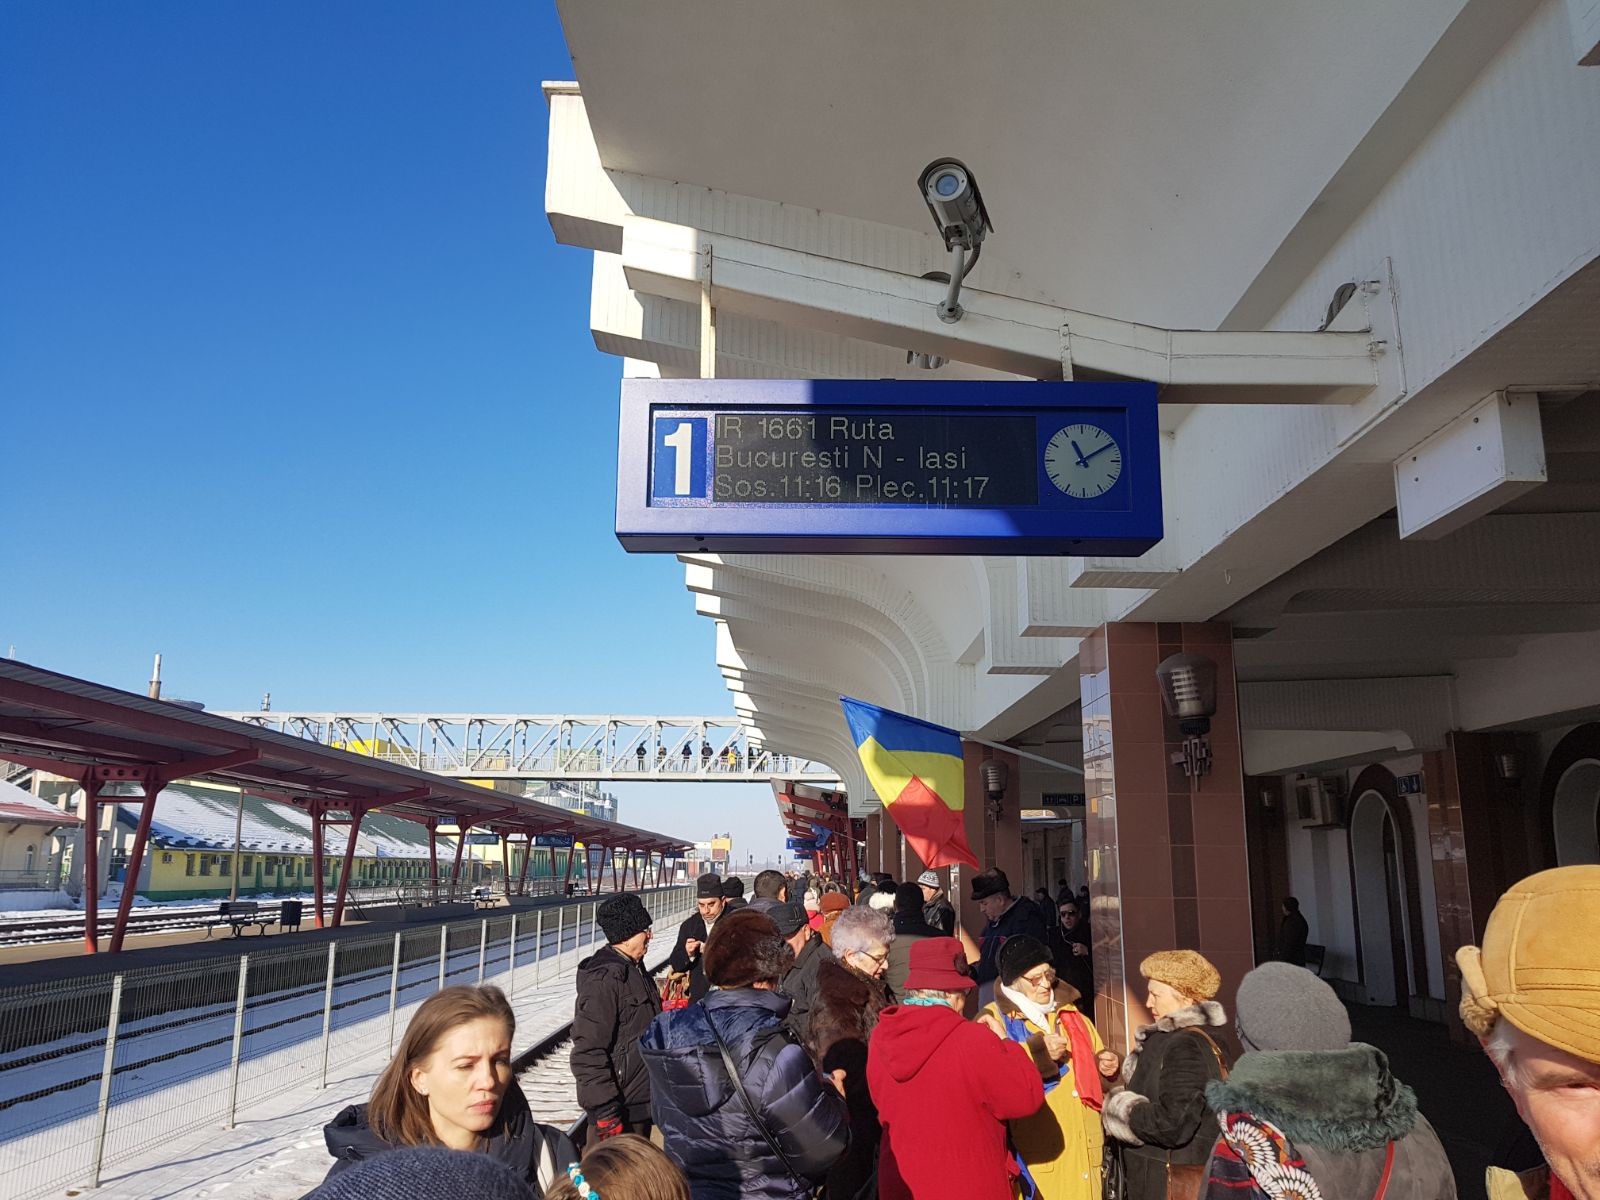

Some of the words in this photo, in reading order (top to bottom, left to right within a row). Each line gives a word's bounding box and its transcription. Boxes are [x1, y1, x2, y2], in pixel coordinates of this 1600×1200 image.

[716, 416, 742, 439] IR
[758, 417, 816, 440] 1661
[830, 416, 895, 440] Ruta
[664, 422, 692, 495] 1
[716, 445, 849, 468] Bucuresti
[863, 445, 882, 469] N
[919, 446, 966, 469] Iasi
